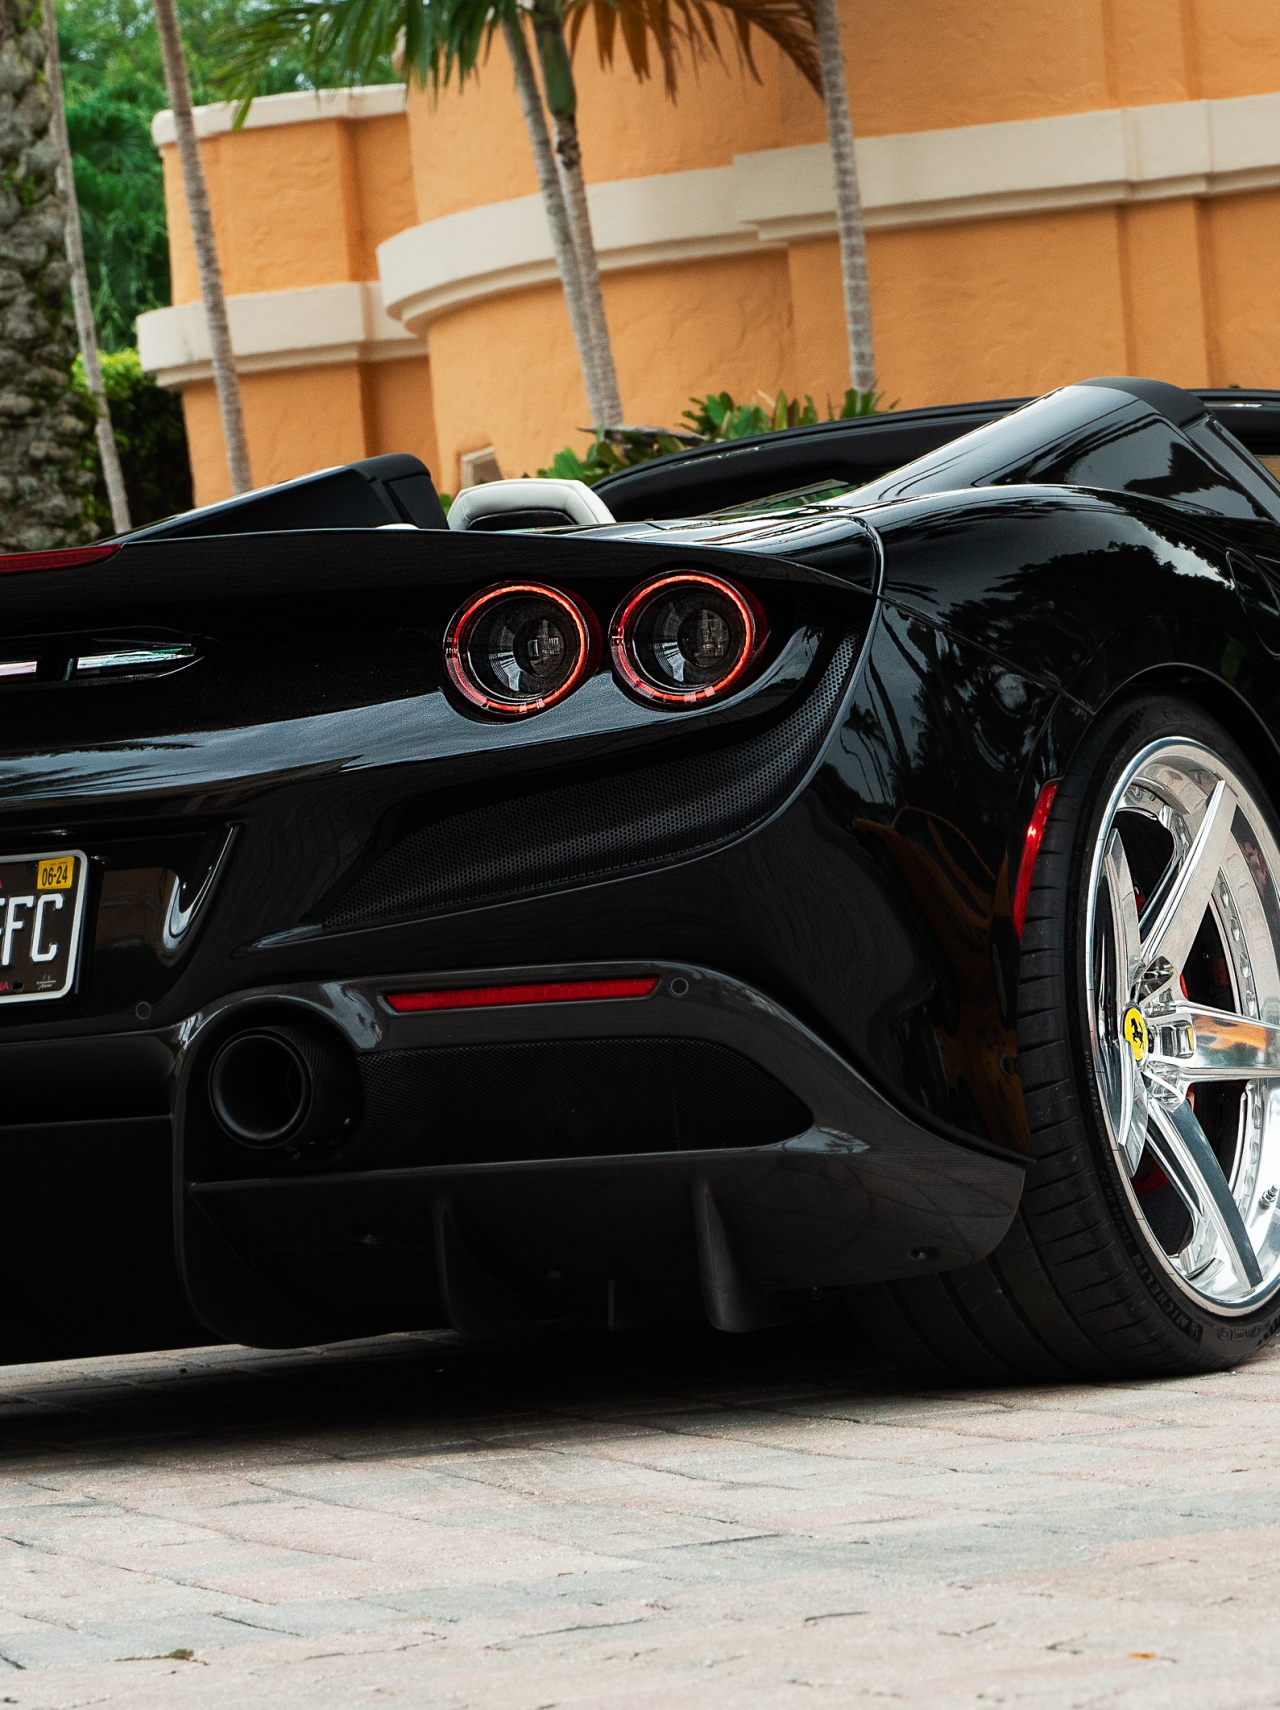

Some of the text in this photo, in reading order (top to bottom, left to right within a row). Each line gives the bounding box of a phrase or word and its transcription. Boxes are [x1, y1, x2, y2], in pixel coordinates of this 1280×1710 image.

[42, 865, 68, 886] 06-24
[0, 893, 64, 966] FC
[1130, 1252, 1190, 1327] MICHELIN
